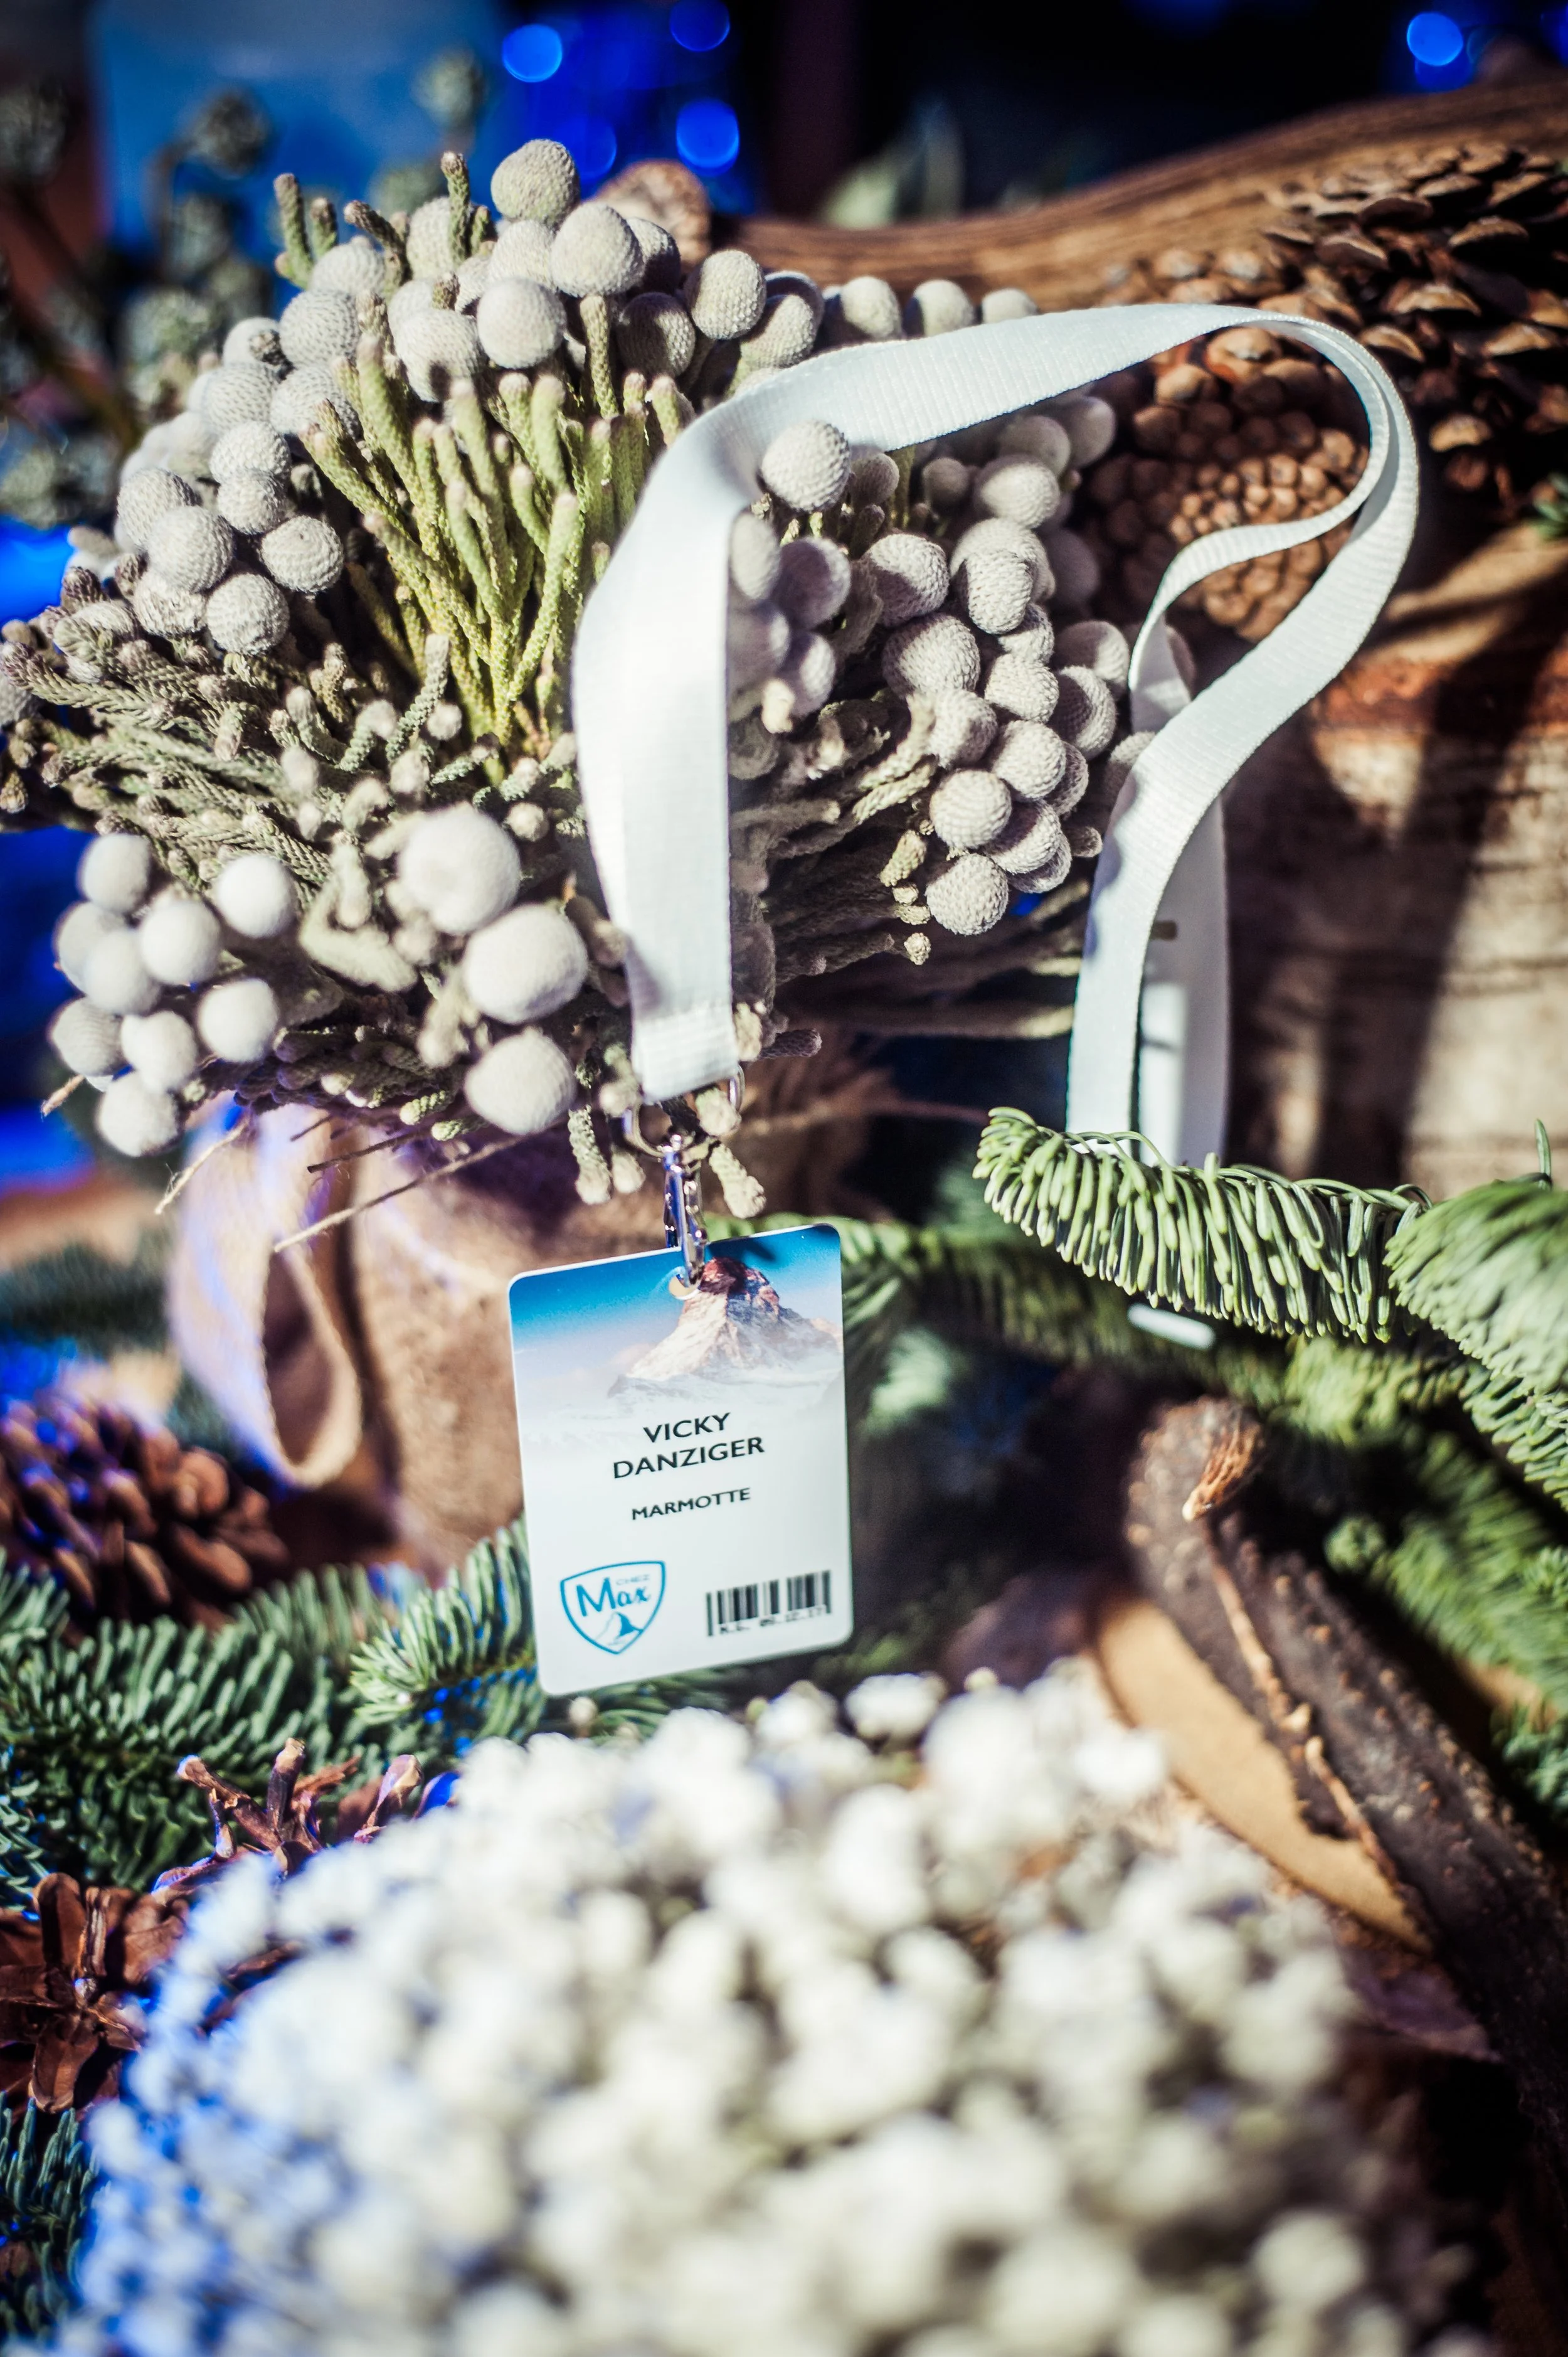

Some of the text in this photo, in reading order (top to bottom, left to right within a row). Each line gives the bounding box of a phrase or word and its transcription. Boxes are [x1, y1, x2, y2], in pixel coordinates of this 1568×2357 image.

[643, 1412, 731, 1443] VICKY
[613, 1437, 765, 1479] DANZIGER
[632, 1487, 751, 1520] MARMOTTE
[576, 1577, 650, 1617] Max
